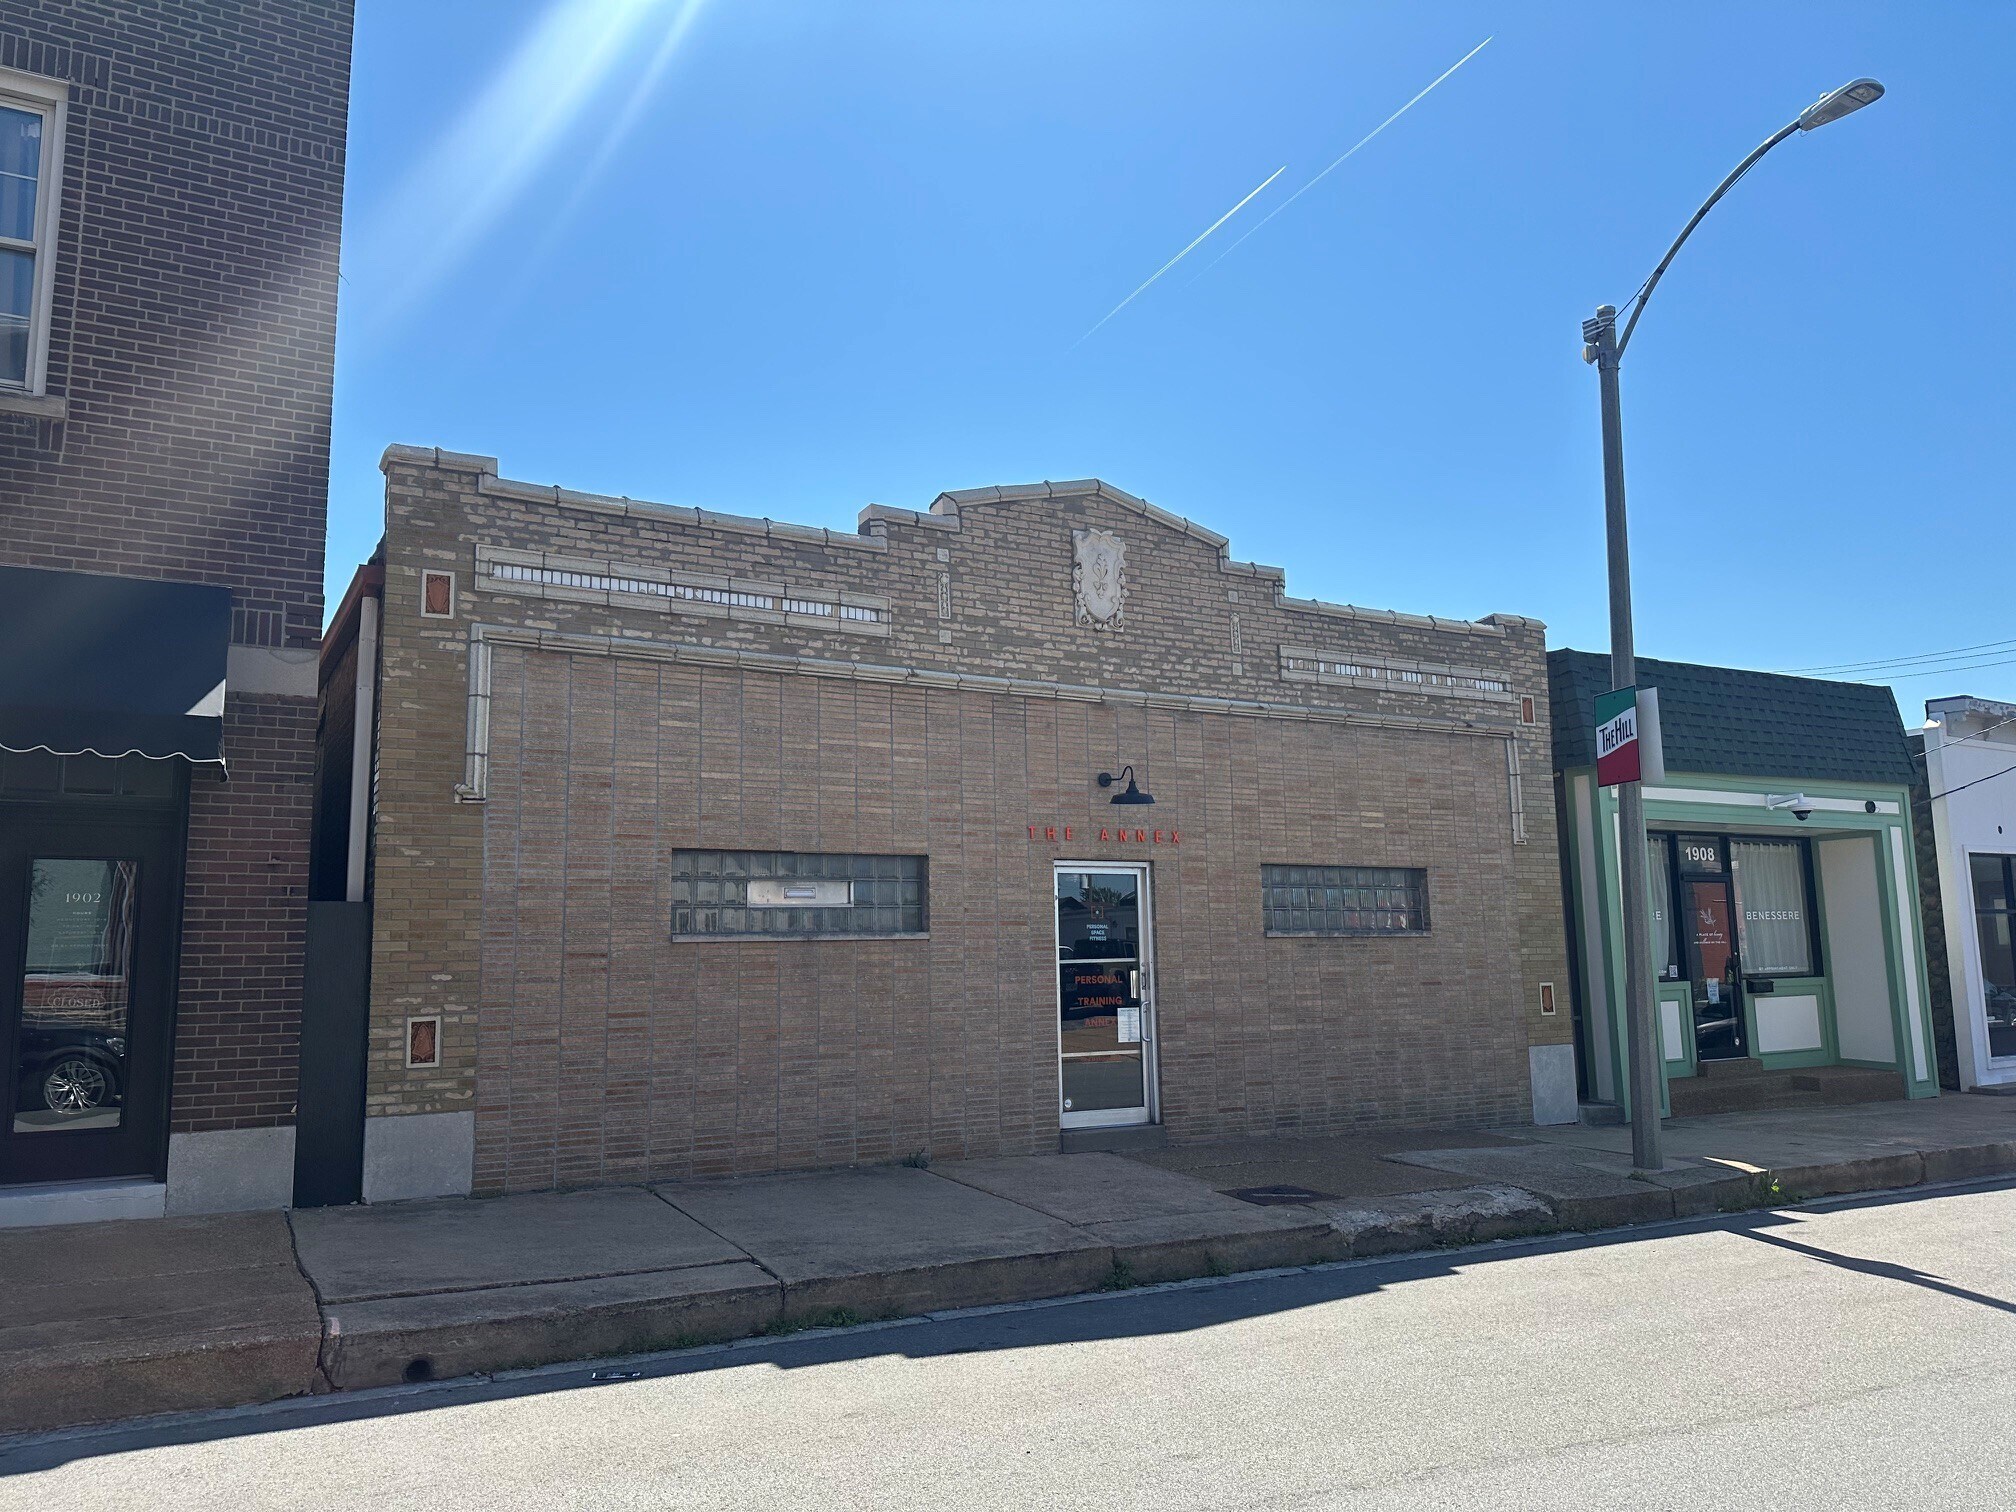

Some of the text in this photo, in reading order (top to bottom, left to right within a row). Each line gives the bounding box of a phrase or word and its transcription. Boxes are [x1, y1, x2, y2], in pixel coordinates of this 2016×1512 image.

[1028, 825, 1180, 843] THE ANNEX
[1685, 846, 1715, 862] 1908
[65, 892, 101, 903] 1902
[1745, 911, 1800, 920] BENESSERE
[1074, 975, 1123, 985] PERSONAL
[53, 996, 100, 1008] CLOSED
[1077, 996, 1123, 1006] TRAINING
[1084, 1018, 1117, 1028] ANNEX
